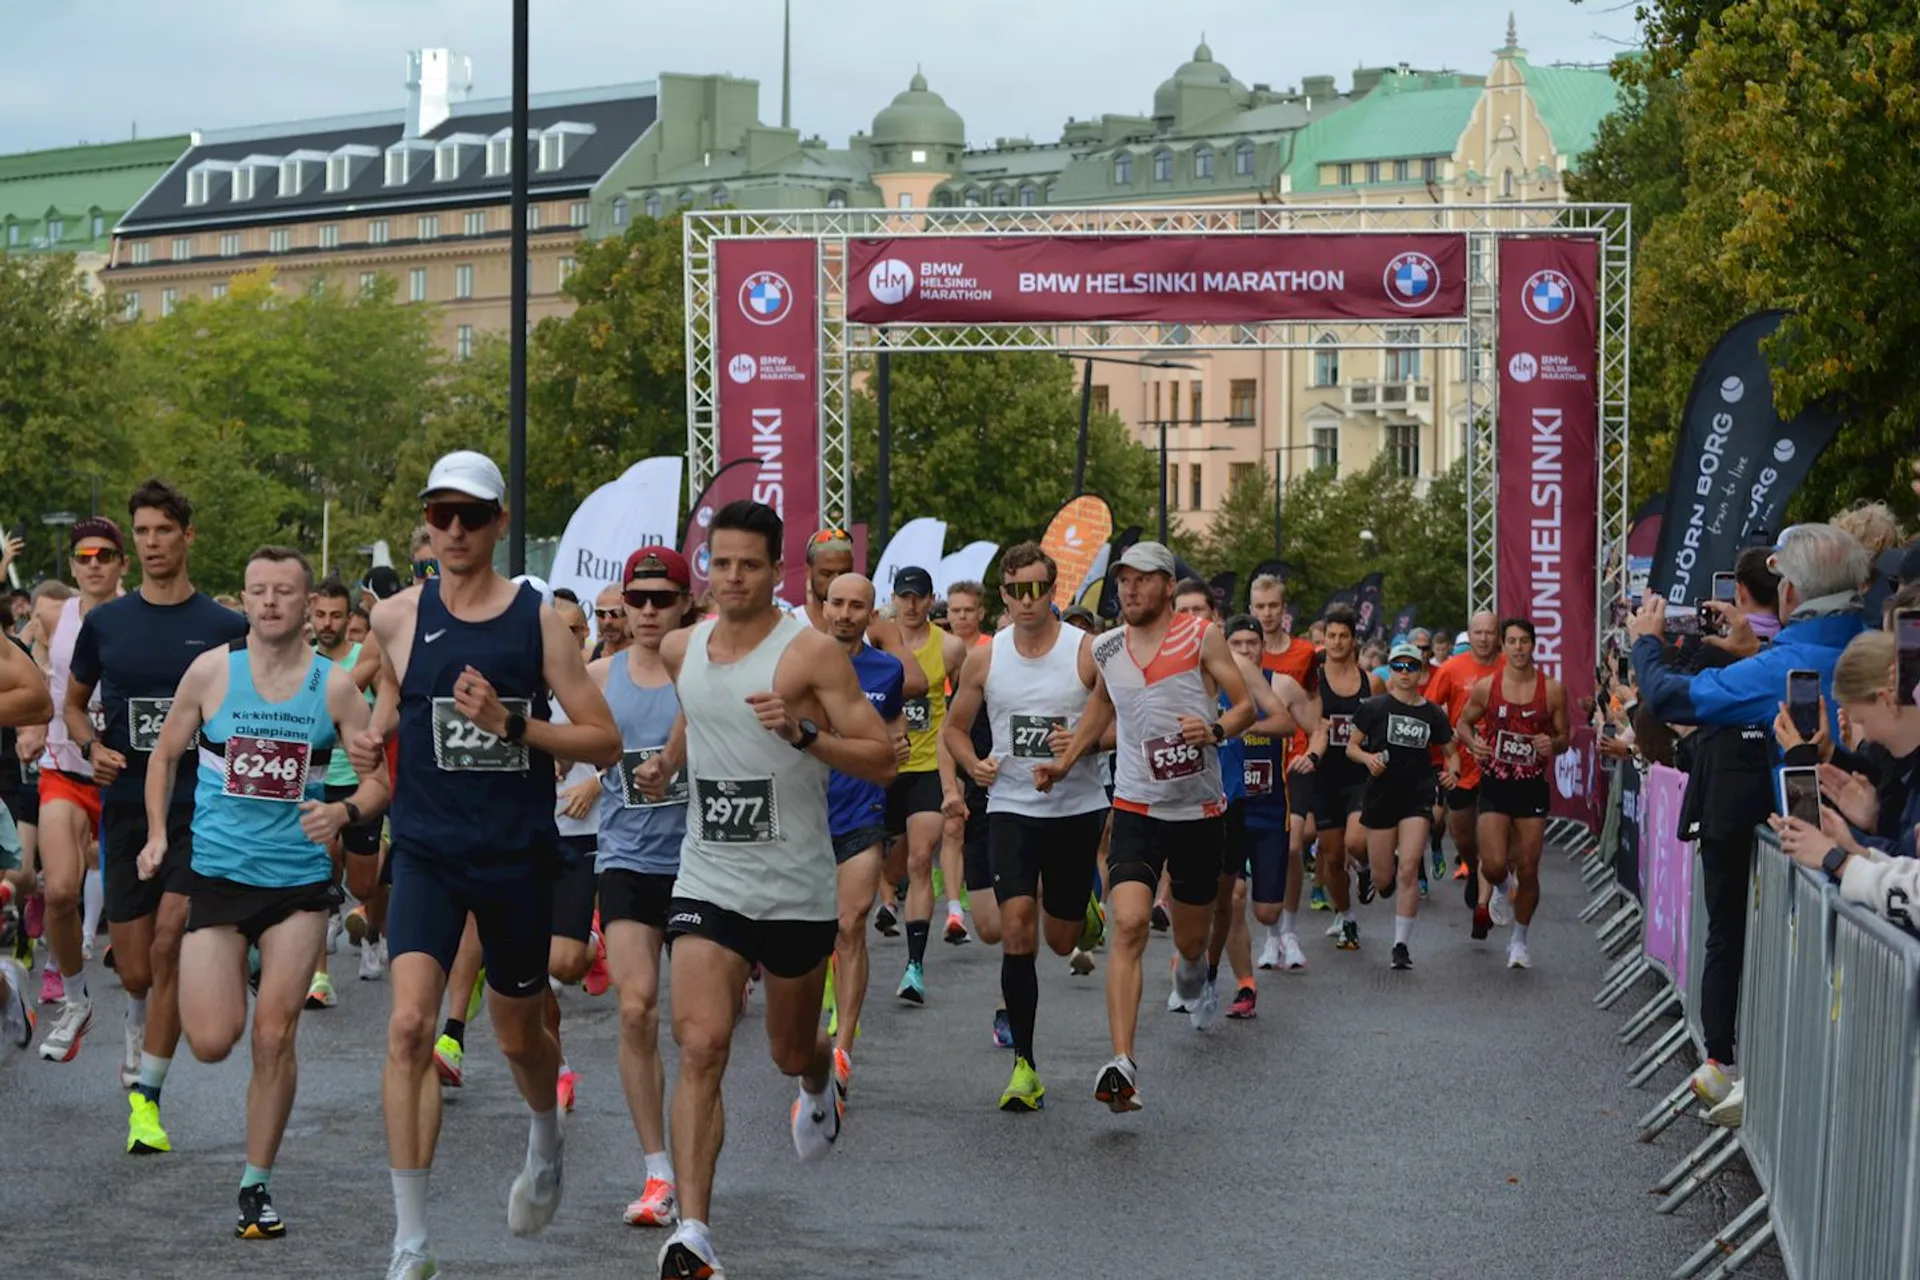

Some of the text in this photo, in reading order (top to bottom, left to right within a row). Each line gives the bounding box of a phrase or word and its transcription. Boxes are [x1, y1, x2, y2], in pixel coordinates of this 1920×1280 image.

[920, 263, 964, 276] BMW
[920, 278, 977, 289] HELSINKI
[1019, 270, 1345, 293] BMW HELSINKI MARATHON
[920, 289, 992, 300] MARATHON
[760, 356, 788, 365] BMW
[1541, 355, 1569, 364] BMW
[1669, 412, 1733, 605] BJÖRN BORG
[139, 714, 163, 735] 26
[232, 711, 315, 725] Kirkintilloch
[236, 725, 308, 739] Olympians
[1015, 726, 1049, 747] 277
[1395, 722, 1424, 738] 3601
[233, 753, 299, 781] 6248
[705, 796, 764, 826] 2977
